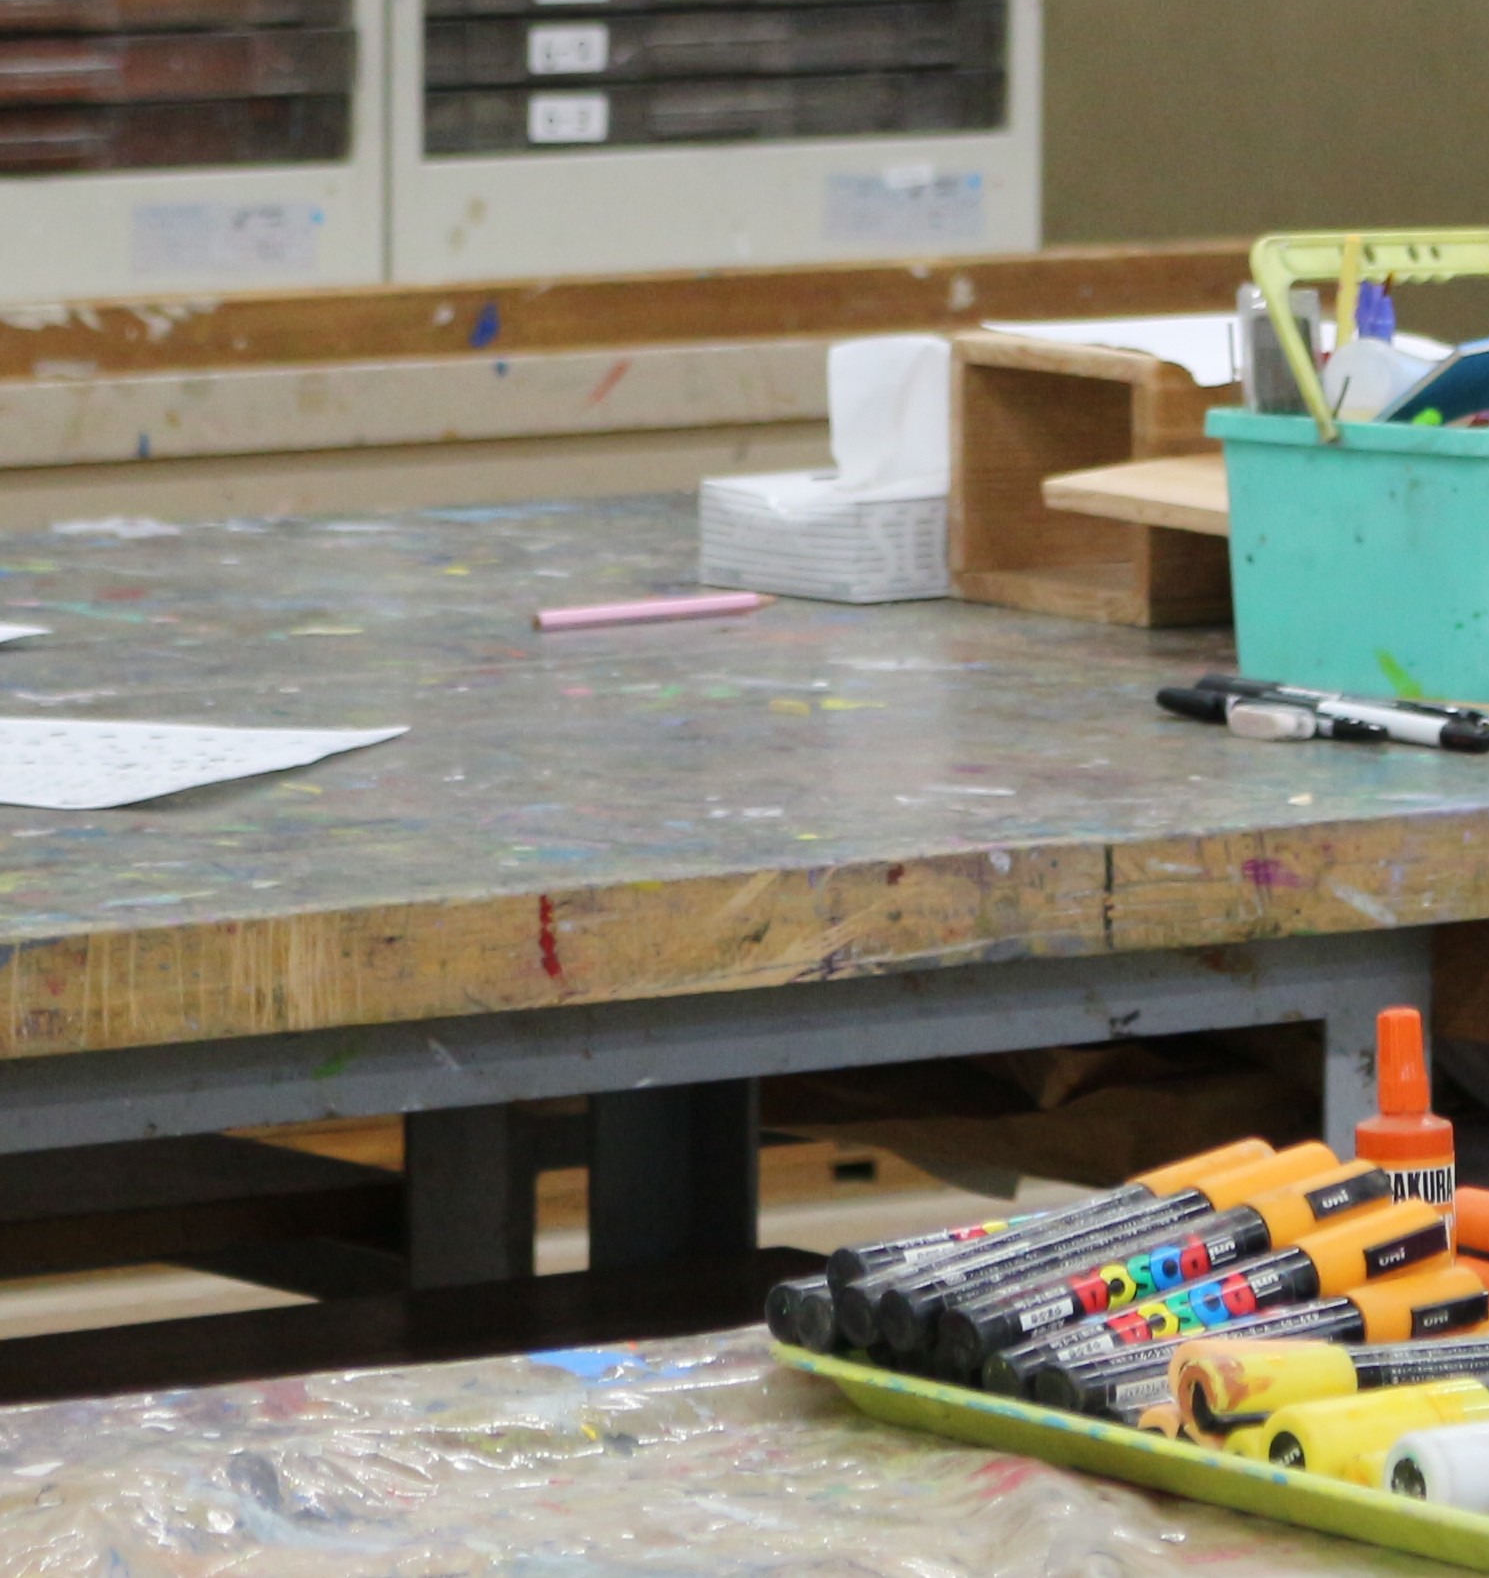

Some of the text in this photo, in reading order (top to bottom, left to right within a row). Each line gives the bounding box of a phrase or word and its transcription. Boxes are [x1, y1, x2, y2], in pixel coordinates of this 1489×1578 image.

[1387, 1166, 1454, 1205] AKURA
[1321, 1189, 1349, 1209] uni
[1378, 1247, 1406, 1267] uni
[1423, 1310, 1449, 1327] uni
